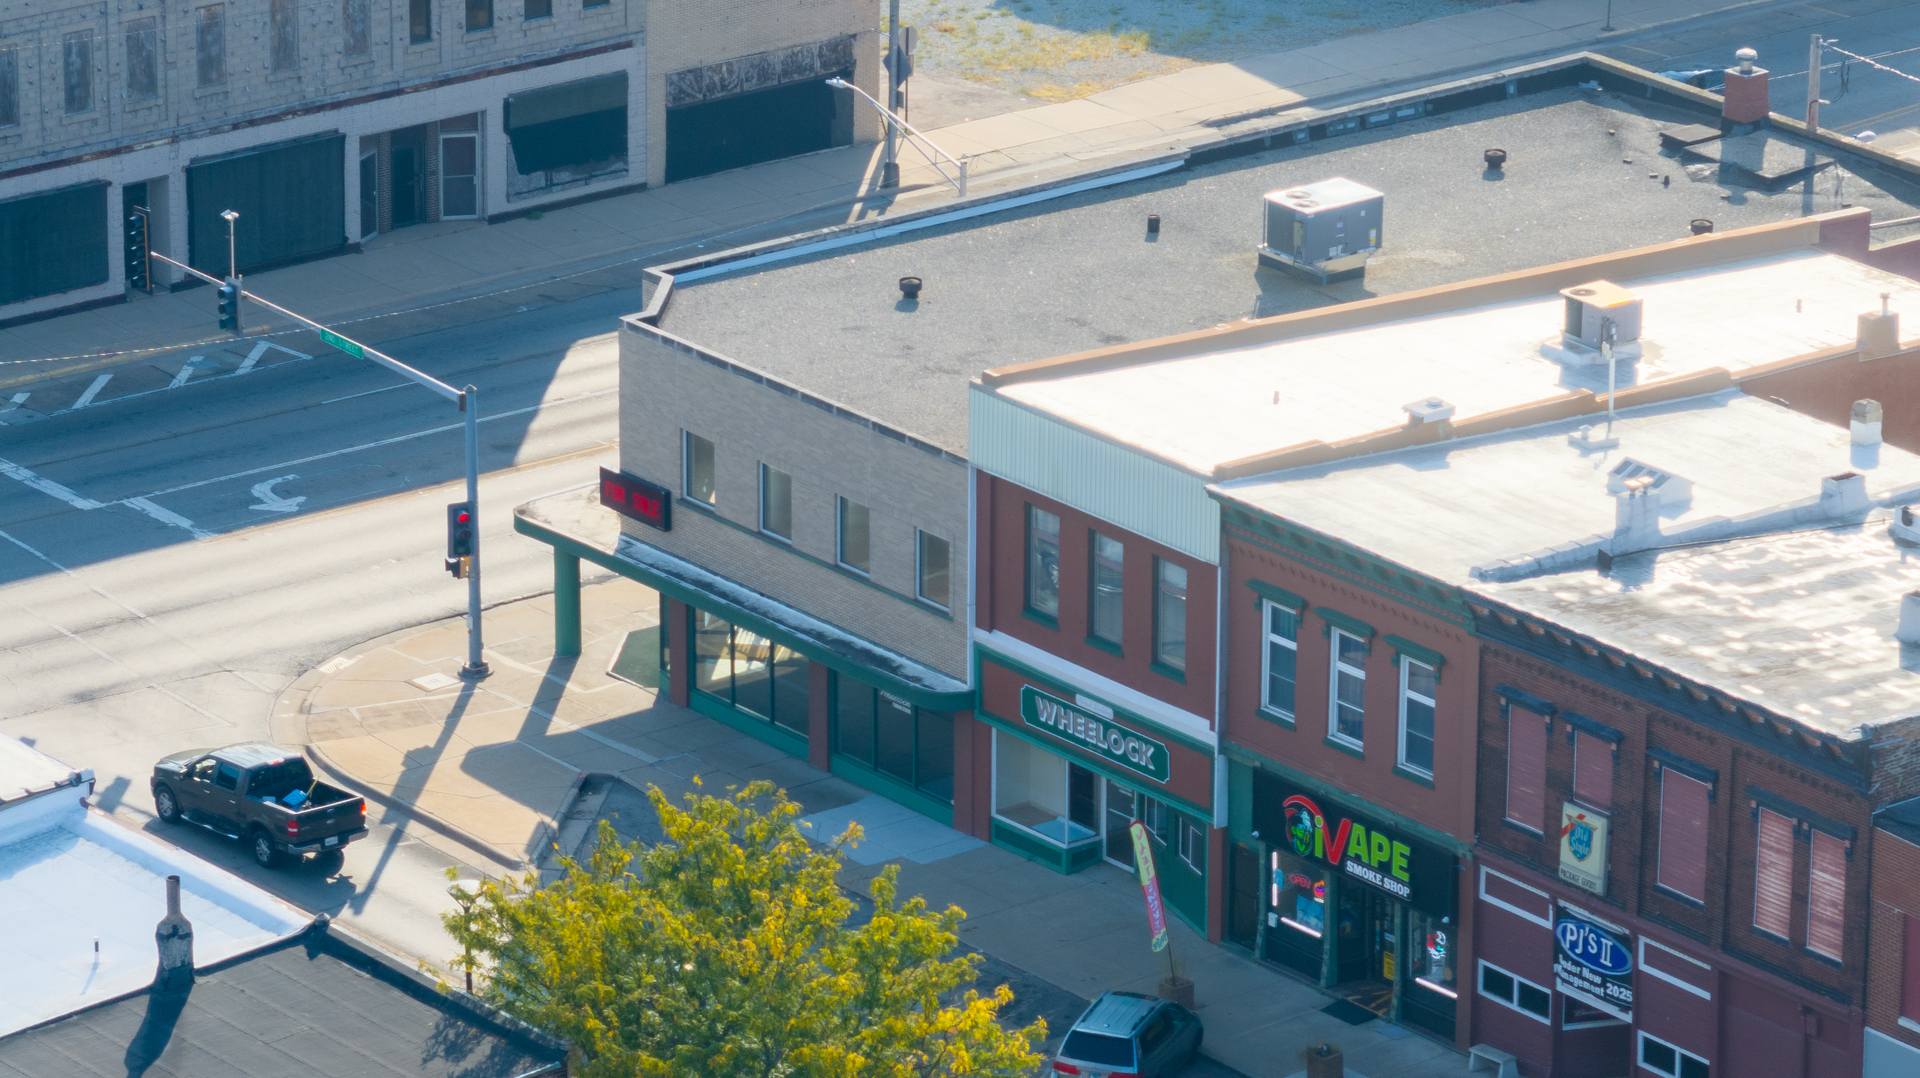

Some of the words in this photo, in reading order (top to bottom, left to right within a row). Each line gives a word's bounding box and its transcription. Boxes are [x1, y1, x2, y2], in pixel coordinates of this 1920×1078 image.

[339, 338, 359, 353] STREET
[605, 481, 625, 504] FOR
[633, 493, 660, 518] SALE
[1035, 695, 1156, 770] WHEELOCK
[1575, 826, 1589, 842] Old
[1289, 873, 1311, 889] OPEN
[1346, 860, 1382, 885] SMOKE
[1383, 877, 1410, 898] SHOP
[1560, 868, 1581, 885] PACKAGE
[1581, 876, 1598, 891] GOODS
[1582, 966, 1602, 984] New
[1606, 983, 1633, 1002] 2025
